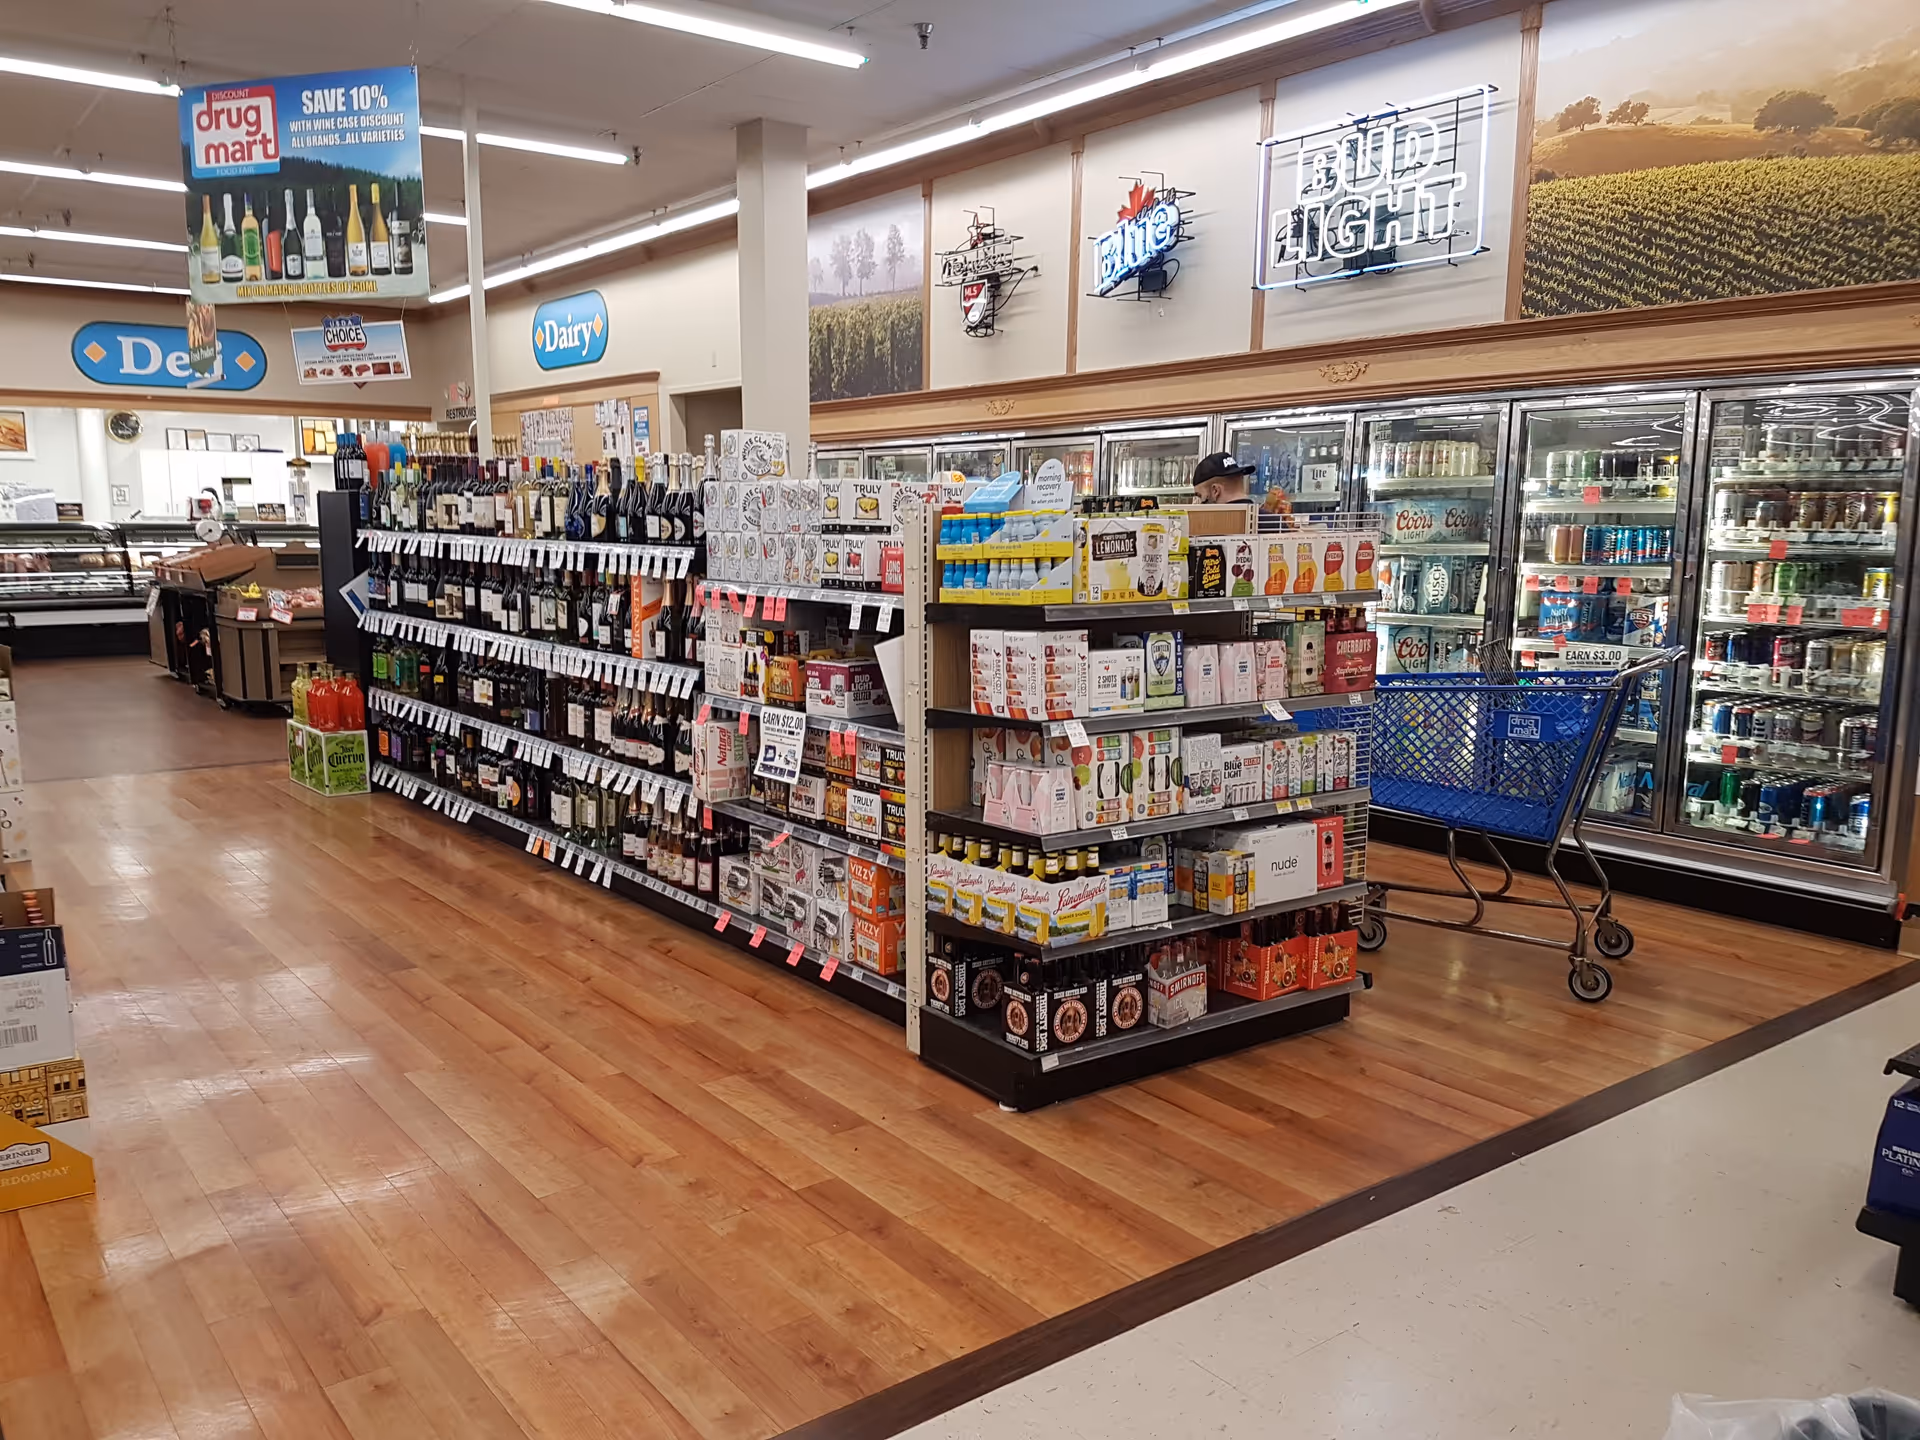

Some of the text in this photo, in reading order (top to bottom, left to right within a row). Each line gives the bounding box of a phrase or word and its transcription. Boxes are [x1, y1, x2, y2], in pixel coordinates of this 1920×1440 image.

[211, 88, 249, 101] DISCOUNT
[301, 84, 389, 115] SAVE 10%
[195, 98, 262, 137] drug
[289, 112, 405, 133] WITH WINE CASE DISCOUNT
[291, 136, 305, 149] ALL
[361, 129, 405, 143] VARIETIES
[204, 133, 280, 165] mart
[1296, 116, 1440, 206] BUD
[216, 166, 237, 176] FOOD
[1269, 171, 1468, 268] LIGHT
[1092, 201, 1180, 294] Blue
[237, 285, 252, 298] MIX
[265, 283, 294, 296] MATCH
[301, 282, 336, 295] BOTTLES
[349, 280, 378, 293] 750ML
[964, 286, 977, 297] MLS
[329, 318, 352, 328] USDA
[325, 326, 362, 344] CHOICE
[544, 313, 593, 357] Dairy
[117, 335, 223, 377] Dei
[446, 406, 476, 420] RESTROOMS
[743, 436, 773, 461] WHITE CLAW
[1038, 473, 1062, 483] morning
[1311, 467, 1327, 480] Lite
[822, 484, 840, 493] TRULY
[853, 484, 882, 494] TRULY
[943, 488, 964, 497] TRULY
[1036, 483, 1062, 491] recovery
[893, 488, 904, 512] WHITE
[1395, 509, 1433, 530] Coors
[1444, 507, 1480, 528] Coors
[1403, 529, 1425, 540] LIGHT
[822, 540, 840, 549] TRULY
[845, 539, 864, 548] TRULY
[1095, 539, 1135, 554] LEMONADE
[887, 560, 901, 573] LONG
[1205, 565, 1220, 575] Cold
[885, 572, 903, 585] DRINK
[1431, 563, 1443, 607] BUSCH
[1092, 587, 1100, 595] 12
[1551, 608, 1568, 616] Natty
[1630, 612, 1655, 622] BEST
[1336, 639, 1372, 655] CIDERBOYS
[1398, 636, 1429, 660] Coo
[1565, 650, 1622, 661] EARN $3.00
[773, 660, 790, 670] TRULY
[1404, 659, 1427, 670] LIGH
[854, 674, 870, 683] BUD
[1102, 675, 1117, 683] SHOTS
[852, 682, 873, 691] LIGHT
[853, 691, 872, 702] SELTZER
[763, 712, 804, 731] EARN $12.00
[1511, 714, 1535, 729] drug
[1513, 727, 1540, 736] mart
[716, 726, 728, 767] Natural
[862, 741, 880, 752] TRULY
[328, 752, 365, 768] Cuervo
[886, 749, 906, 761] TRULY
[1223, 760, 1242, 771] Blue
[1223, 770, 1242, 779] LIGHT
[831, 785, 847, 797] TRUL
[853, 795, 874, 806] TRULY
[887, 804, 906, 816] TRULY
[1271, 856, 1298, 872] nude
[850, 862, 875, 881] VIZZY
[1053, 877, 1107, 916] Leinenkugel's
[1059, 913, 1075, 921] SUMMER
[856, 917, 880, 937] VIZZY
[1169, 972, 1204, 996] SMIRNOFF
[958, 997, 966, 1016] DOG
[1173, 998, 1184, 1011] ICE
[1040, 993, 1048, 1052] THIRSTY DOG
[1099, 1017, 1107, 1036] DOG
[1893, 1099, 1905, 1109] 12
[0, 1147, 43, 1161] ERINGER
[1881, 1147, 1920, 1168] PLATIN
[0, 1165, 71, 1187] RDONNAY
